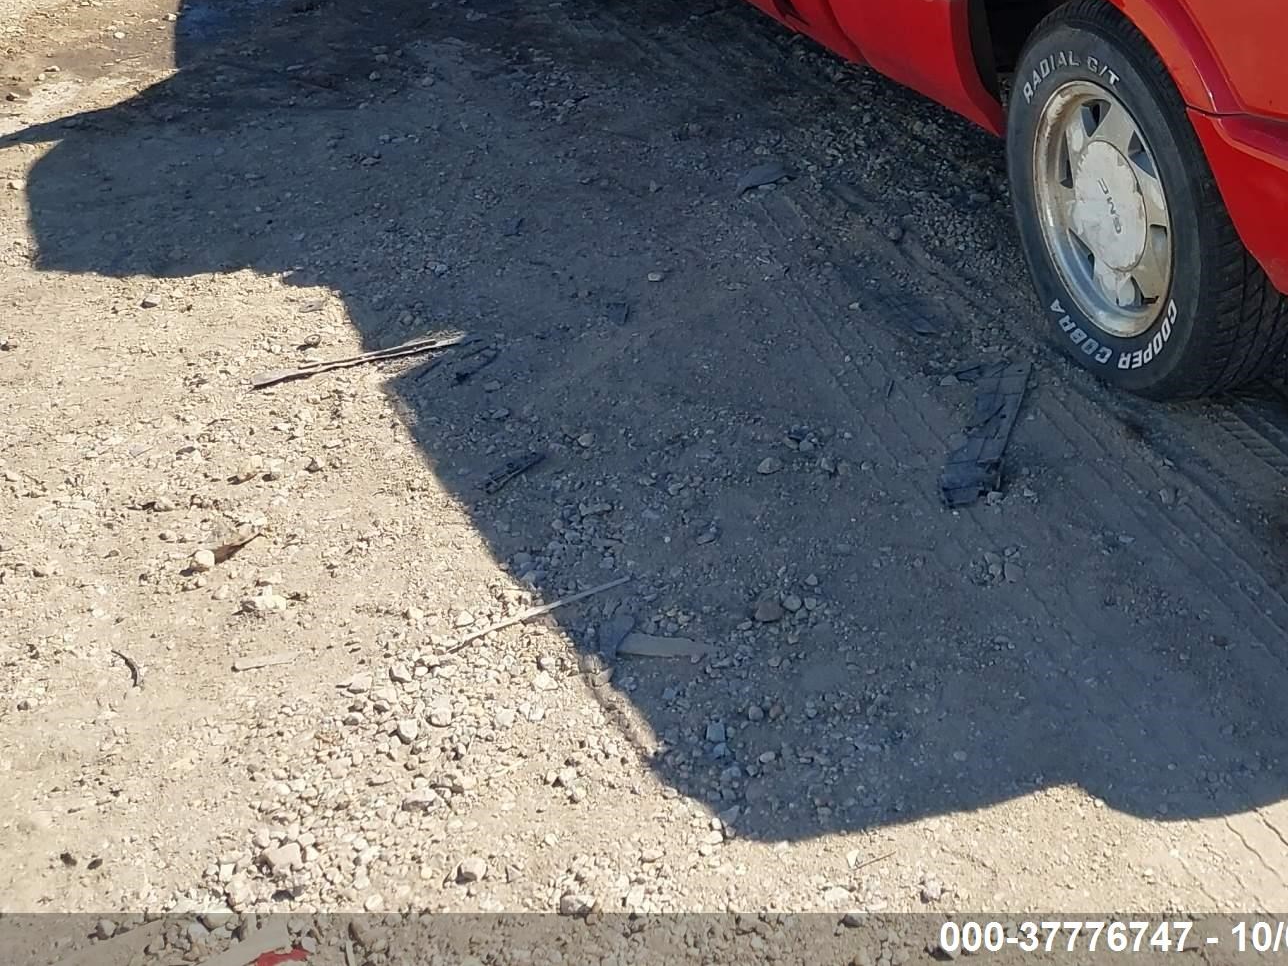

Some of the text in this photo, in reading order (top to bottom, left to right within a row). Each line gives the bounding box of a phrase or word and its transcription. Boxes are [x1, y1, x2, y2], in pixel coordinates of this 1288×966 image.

[1023, 50, 1121, 105] RADIAL G/T
[1050, 298, 1178, 370] COOPER COBRA
